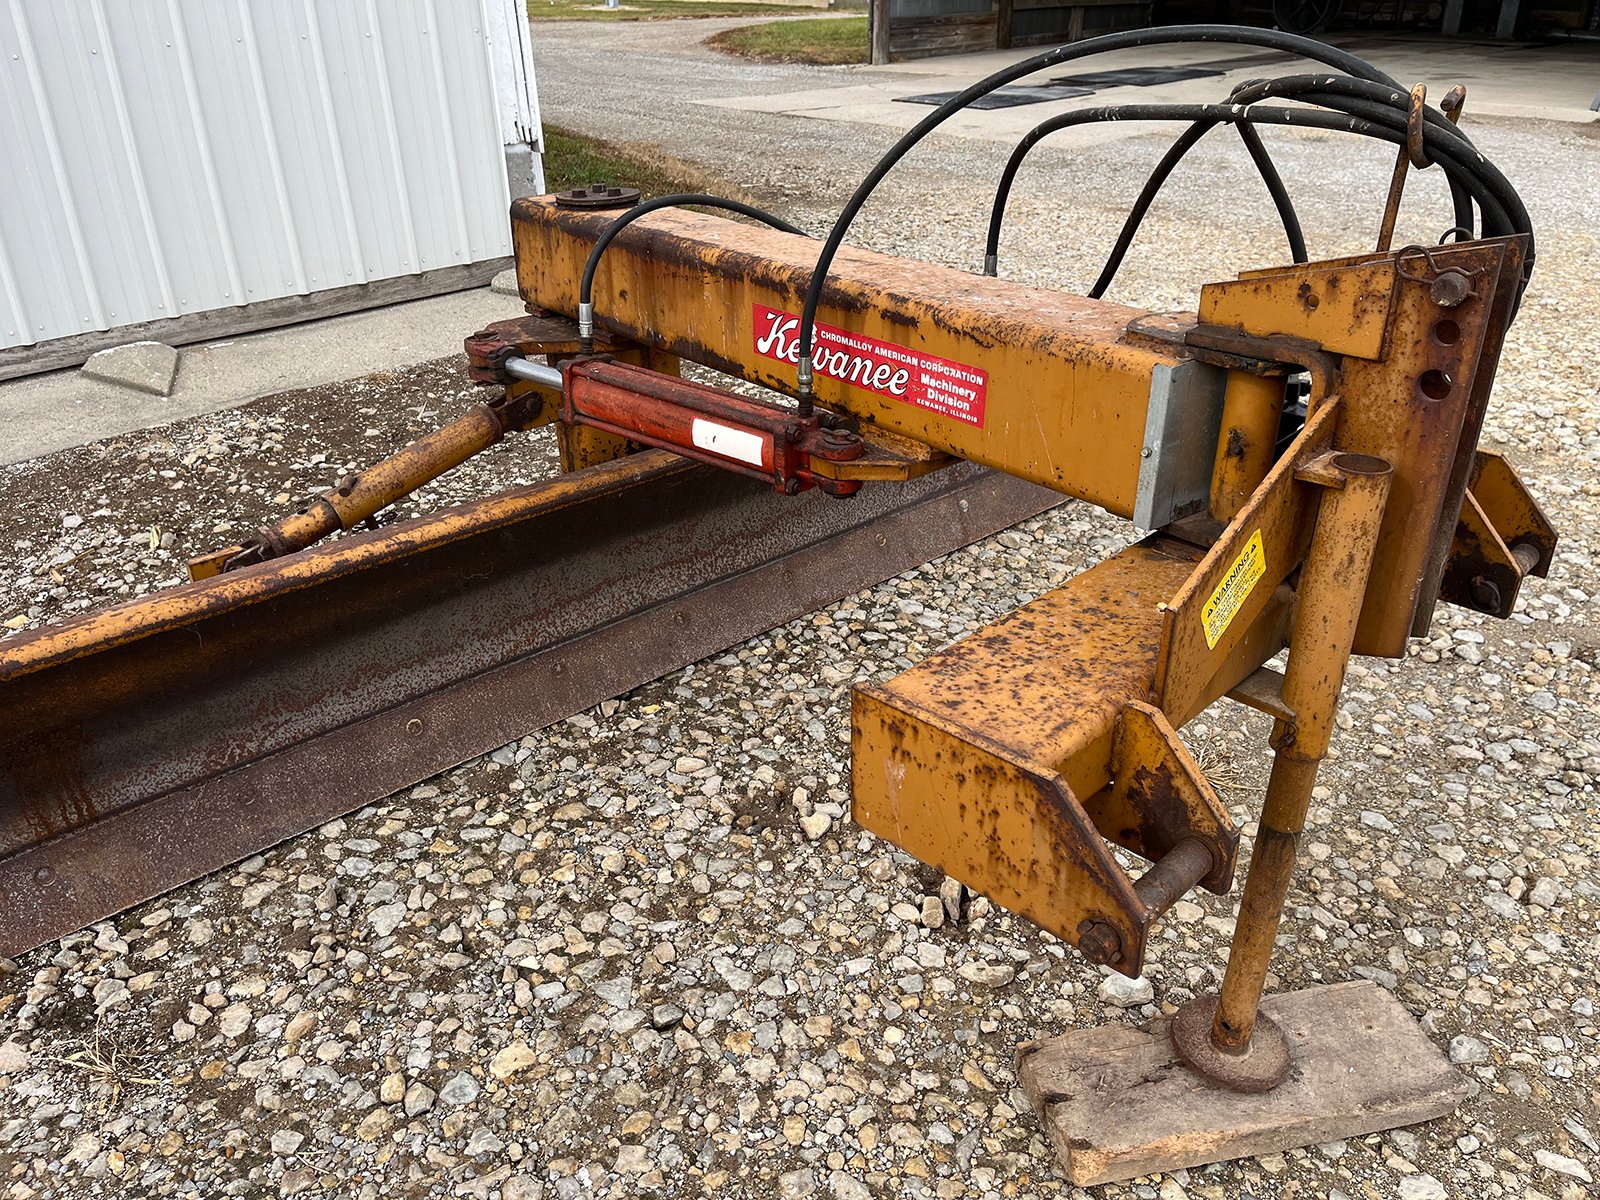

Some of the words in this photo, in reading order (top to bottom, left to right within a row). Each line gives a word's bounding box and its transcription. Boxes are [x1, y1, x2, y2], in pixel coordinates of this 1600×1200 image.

[821, 330, 873, 352] CHROMALLOY
[874, 346, 918, 366] AMERICAN
[920, 360, 983, 386] CORPORATION
[920, 374, 976, 402] Machinery
[927, 388, 970, 411] Division
[916, 399, 949, 415] KEWANEE,
[950, 409, 978, 424] ILLINOIS
[1213, 551, 1250, 606] WARNING
